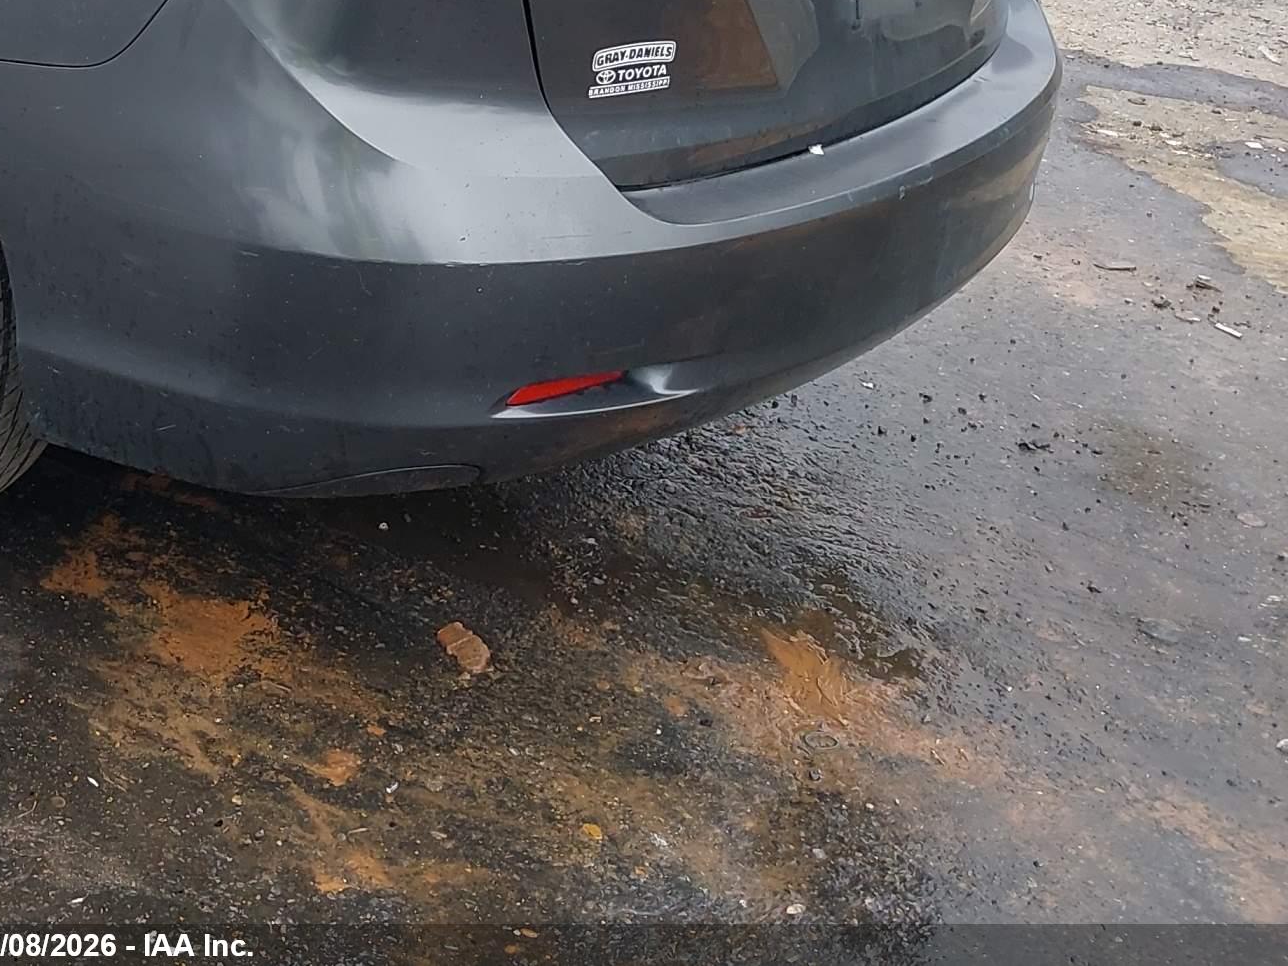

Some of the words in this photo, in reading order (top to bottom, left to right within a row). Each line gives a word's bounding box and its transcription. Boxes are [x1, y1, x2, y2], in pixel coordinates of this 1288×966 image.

[596, 45, 673, 67] GRAY-DANIELS
[617, 64, 667, 81] TOYOTA
[588, 85, 626, 96] BRANDON
